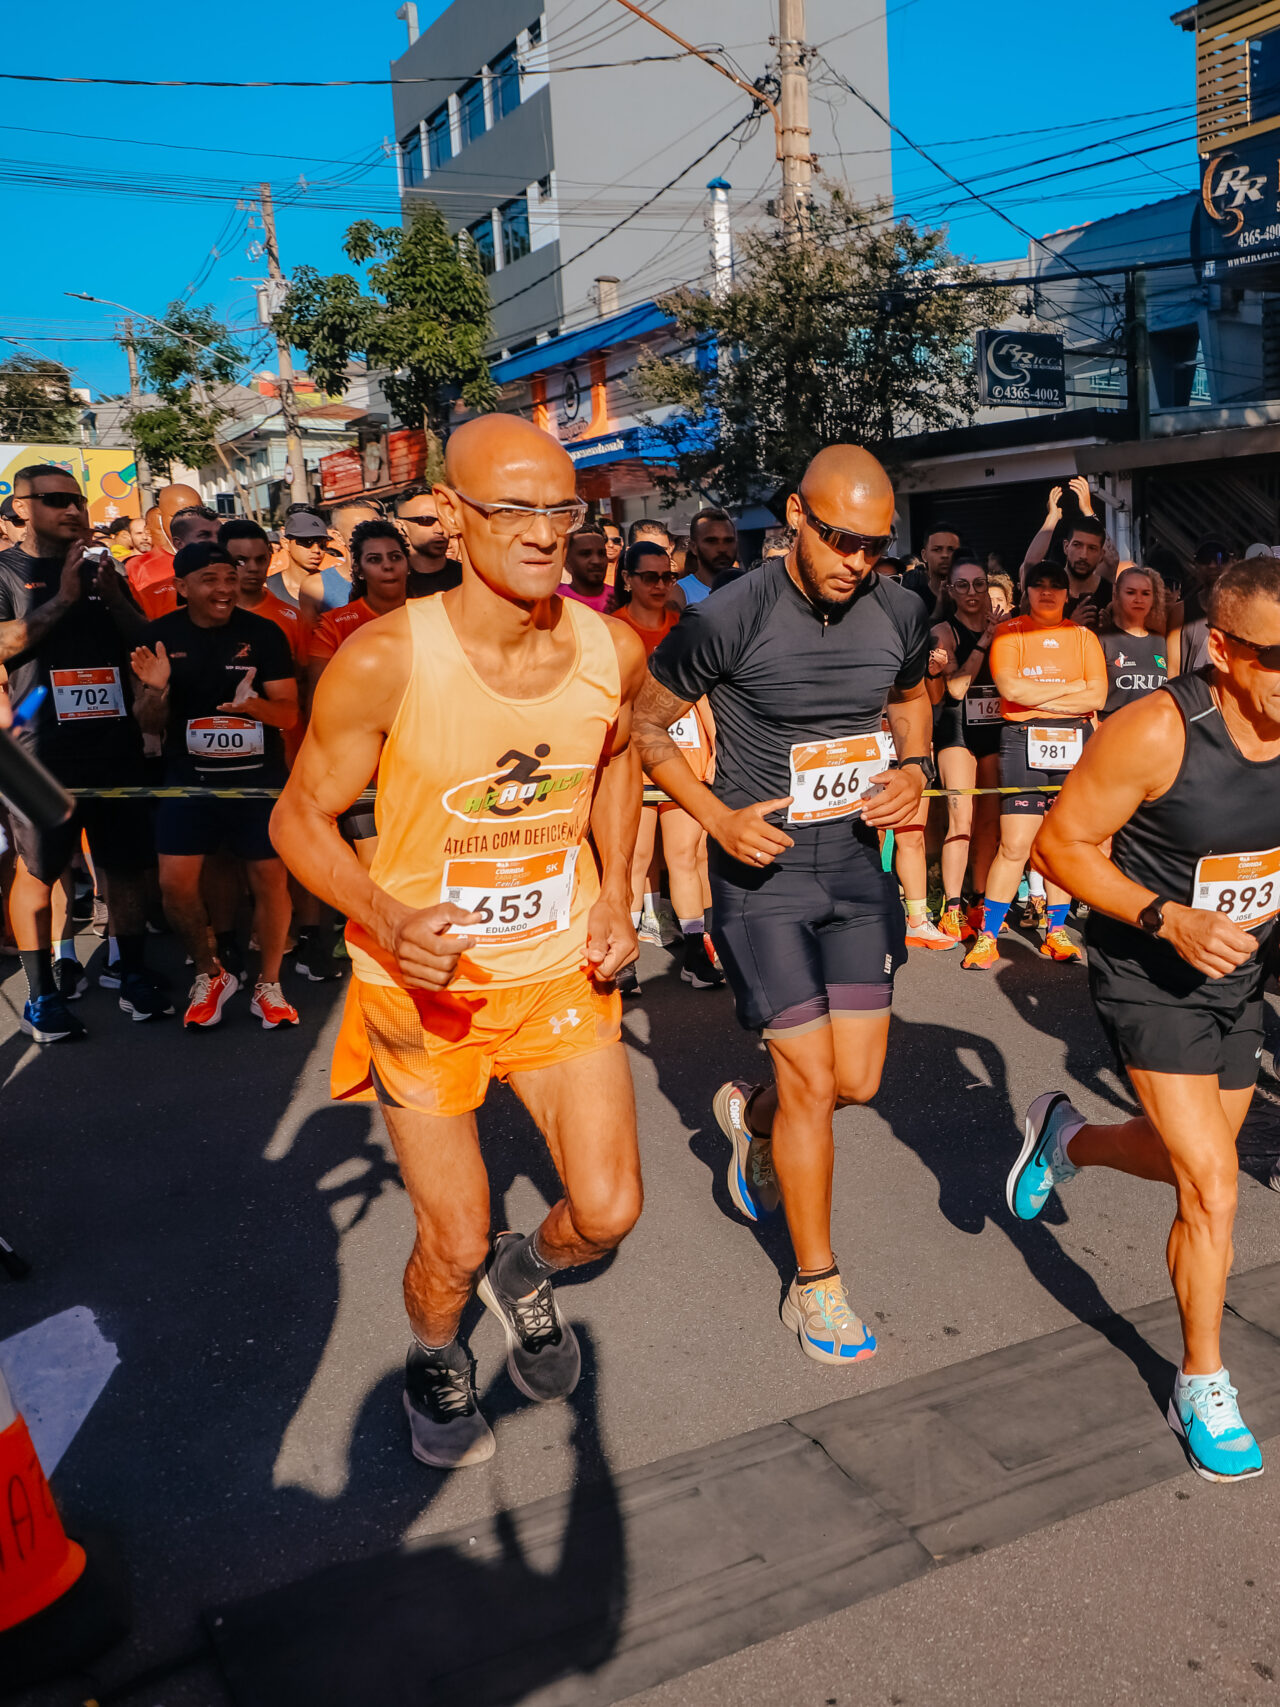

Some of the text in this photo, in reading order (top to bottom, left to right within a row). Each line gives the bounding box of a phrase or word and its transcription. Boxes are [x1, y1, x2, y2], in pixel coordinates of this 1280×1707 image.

[1004, 385, 1060, 401] 4365-4002
[71, 688, 110, 707] 702
[978, 701, 1001, 715] 162
[203, 733, 244, 749] 700
[866, 748, 877, 758] 5K
[1040, 744, 1067, 759] 981
[813, 767, 860, 802] 666
[444, 815, 579, 856] ATLETA COM DEFICIÊN
[545, 862, 559, 874] 5K
[1216, 881, 1274, 915] 893
[471, 889, 543, 925] 653
[1234, 913, 1253, 922] JOSE
[485, 922, 528, 934] EDUARDO
